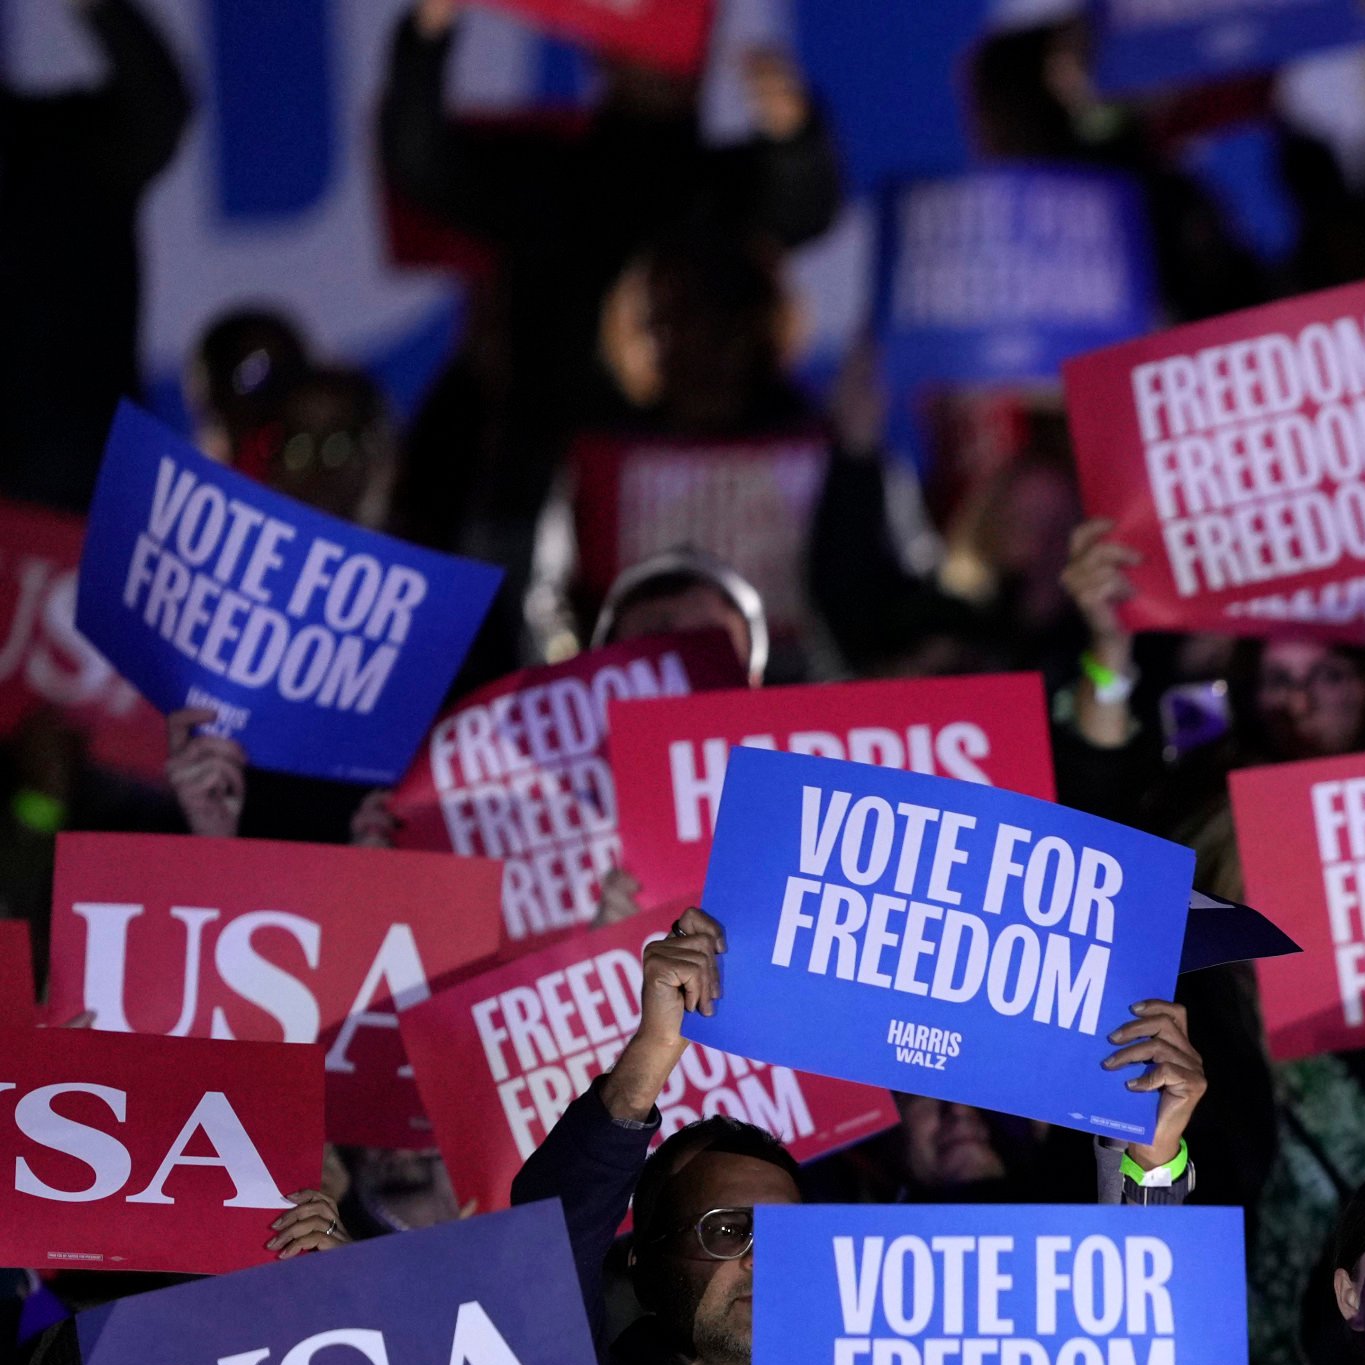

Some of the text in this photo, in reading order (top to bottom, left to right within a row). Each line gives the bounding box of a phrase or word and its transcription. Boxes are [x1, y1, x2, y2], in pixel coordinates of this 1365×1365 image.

[123, 533, 401, 715] FREEDOM
[148, 456, 295, 602] VOTE
[287, 538, 427, 642] FOR
[799, 785, 1125, 943] VOTE FOR
[72, 903, 432, 1077] USA
[771, 875, 1112, 1036] FREEDOM
[887, 1018, 963, 1058] HARRIS
[895, 1046, 948, 1070] WALZ
[0, 1081, 296, 1209] SA
[833, 1235, 1175, 1337] VOTE FOR
